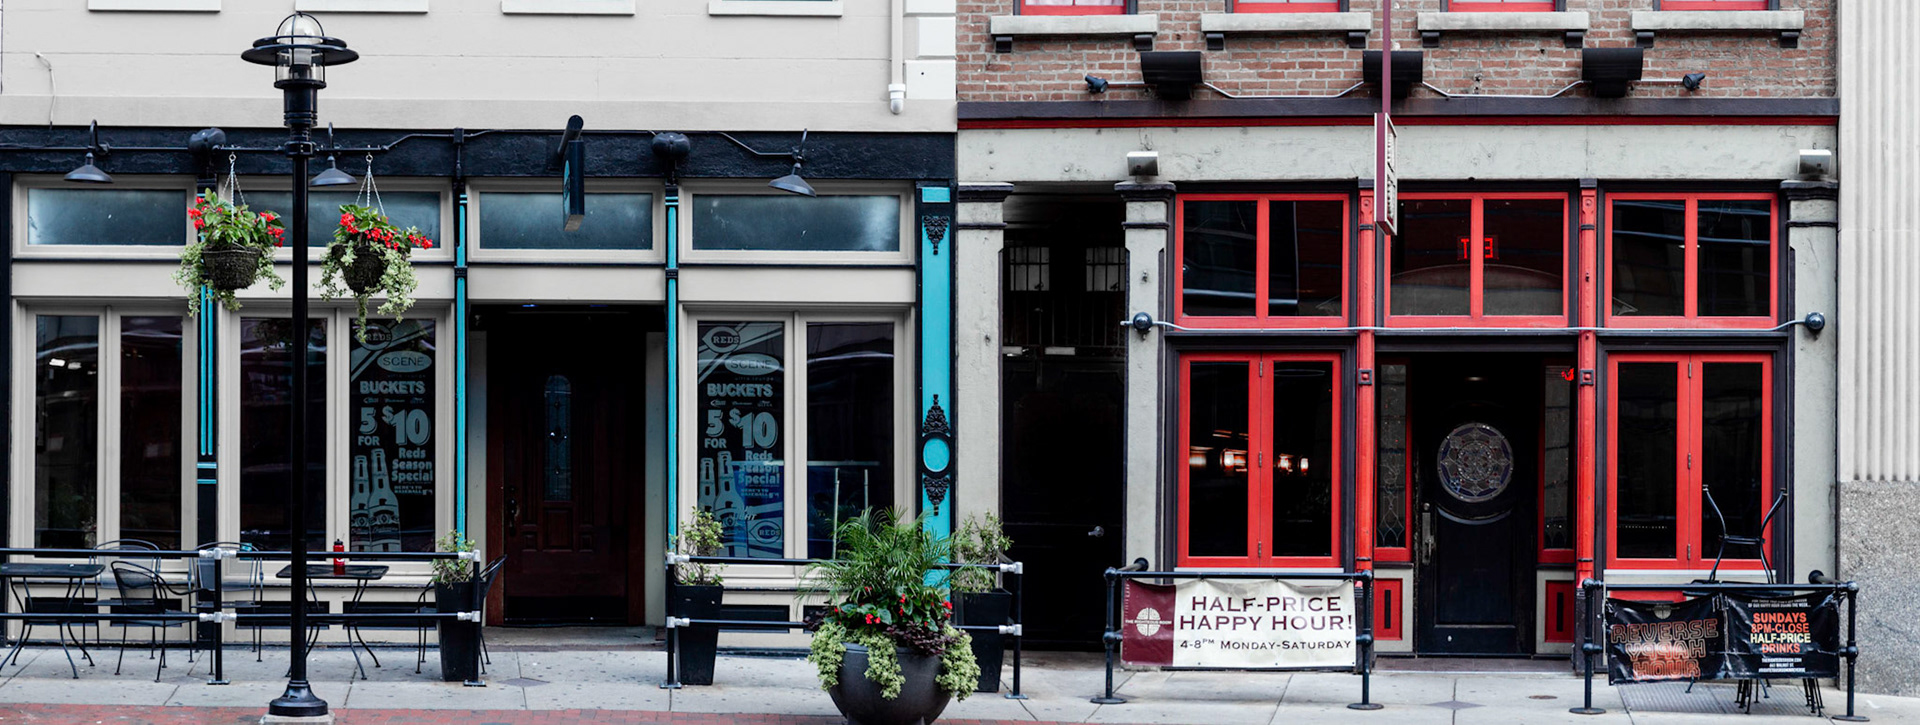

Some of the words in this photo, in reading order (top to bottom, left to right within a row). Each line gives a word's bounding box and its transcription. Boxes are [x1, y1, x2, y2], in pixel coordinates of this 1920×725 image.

[713, 336, 740, 344] REDS
[382, 356, 425, 366] SCENE
[731, 360, 771, 369] SCENE
[360, 381, 425, 394] BUCKETS
[707, 383, 773, 397] BUCKETS
[359, 407, 378, 435] 5
[706, 409, 724, 437] 5
[358, 436, 380, 446] FOR
[704, 438, 727, 449] FOR
[399, 447, 426, 459] Reds
[745, 450, 773, 461] Reds
[392, 459, 433, 470] Season
[391, 470, 433, 483] Special
[738, 473, 780, 486] Special
[759, 529, 781, 537] REDS
[1192, 596, 1342, 612] HALF-PRICE
[1180, 615, 1262, 631] HAPPY
[1272, 615, 1353, 630] HOUR!
[1753, 612, 1807, 623] SUNDAYS
[1610, 618, 1719, 644] REVERSE
[1751, 623, 1810, 634] 8PM-CLOSE
[1750, 633, 1812, 643] HALF-PRICE
[1761, 643, 1801, 653] DRINKS
[1633, 659, 1701, 680] HOUR
